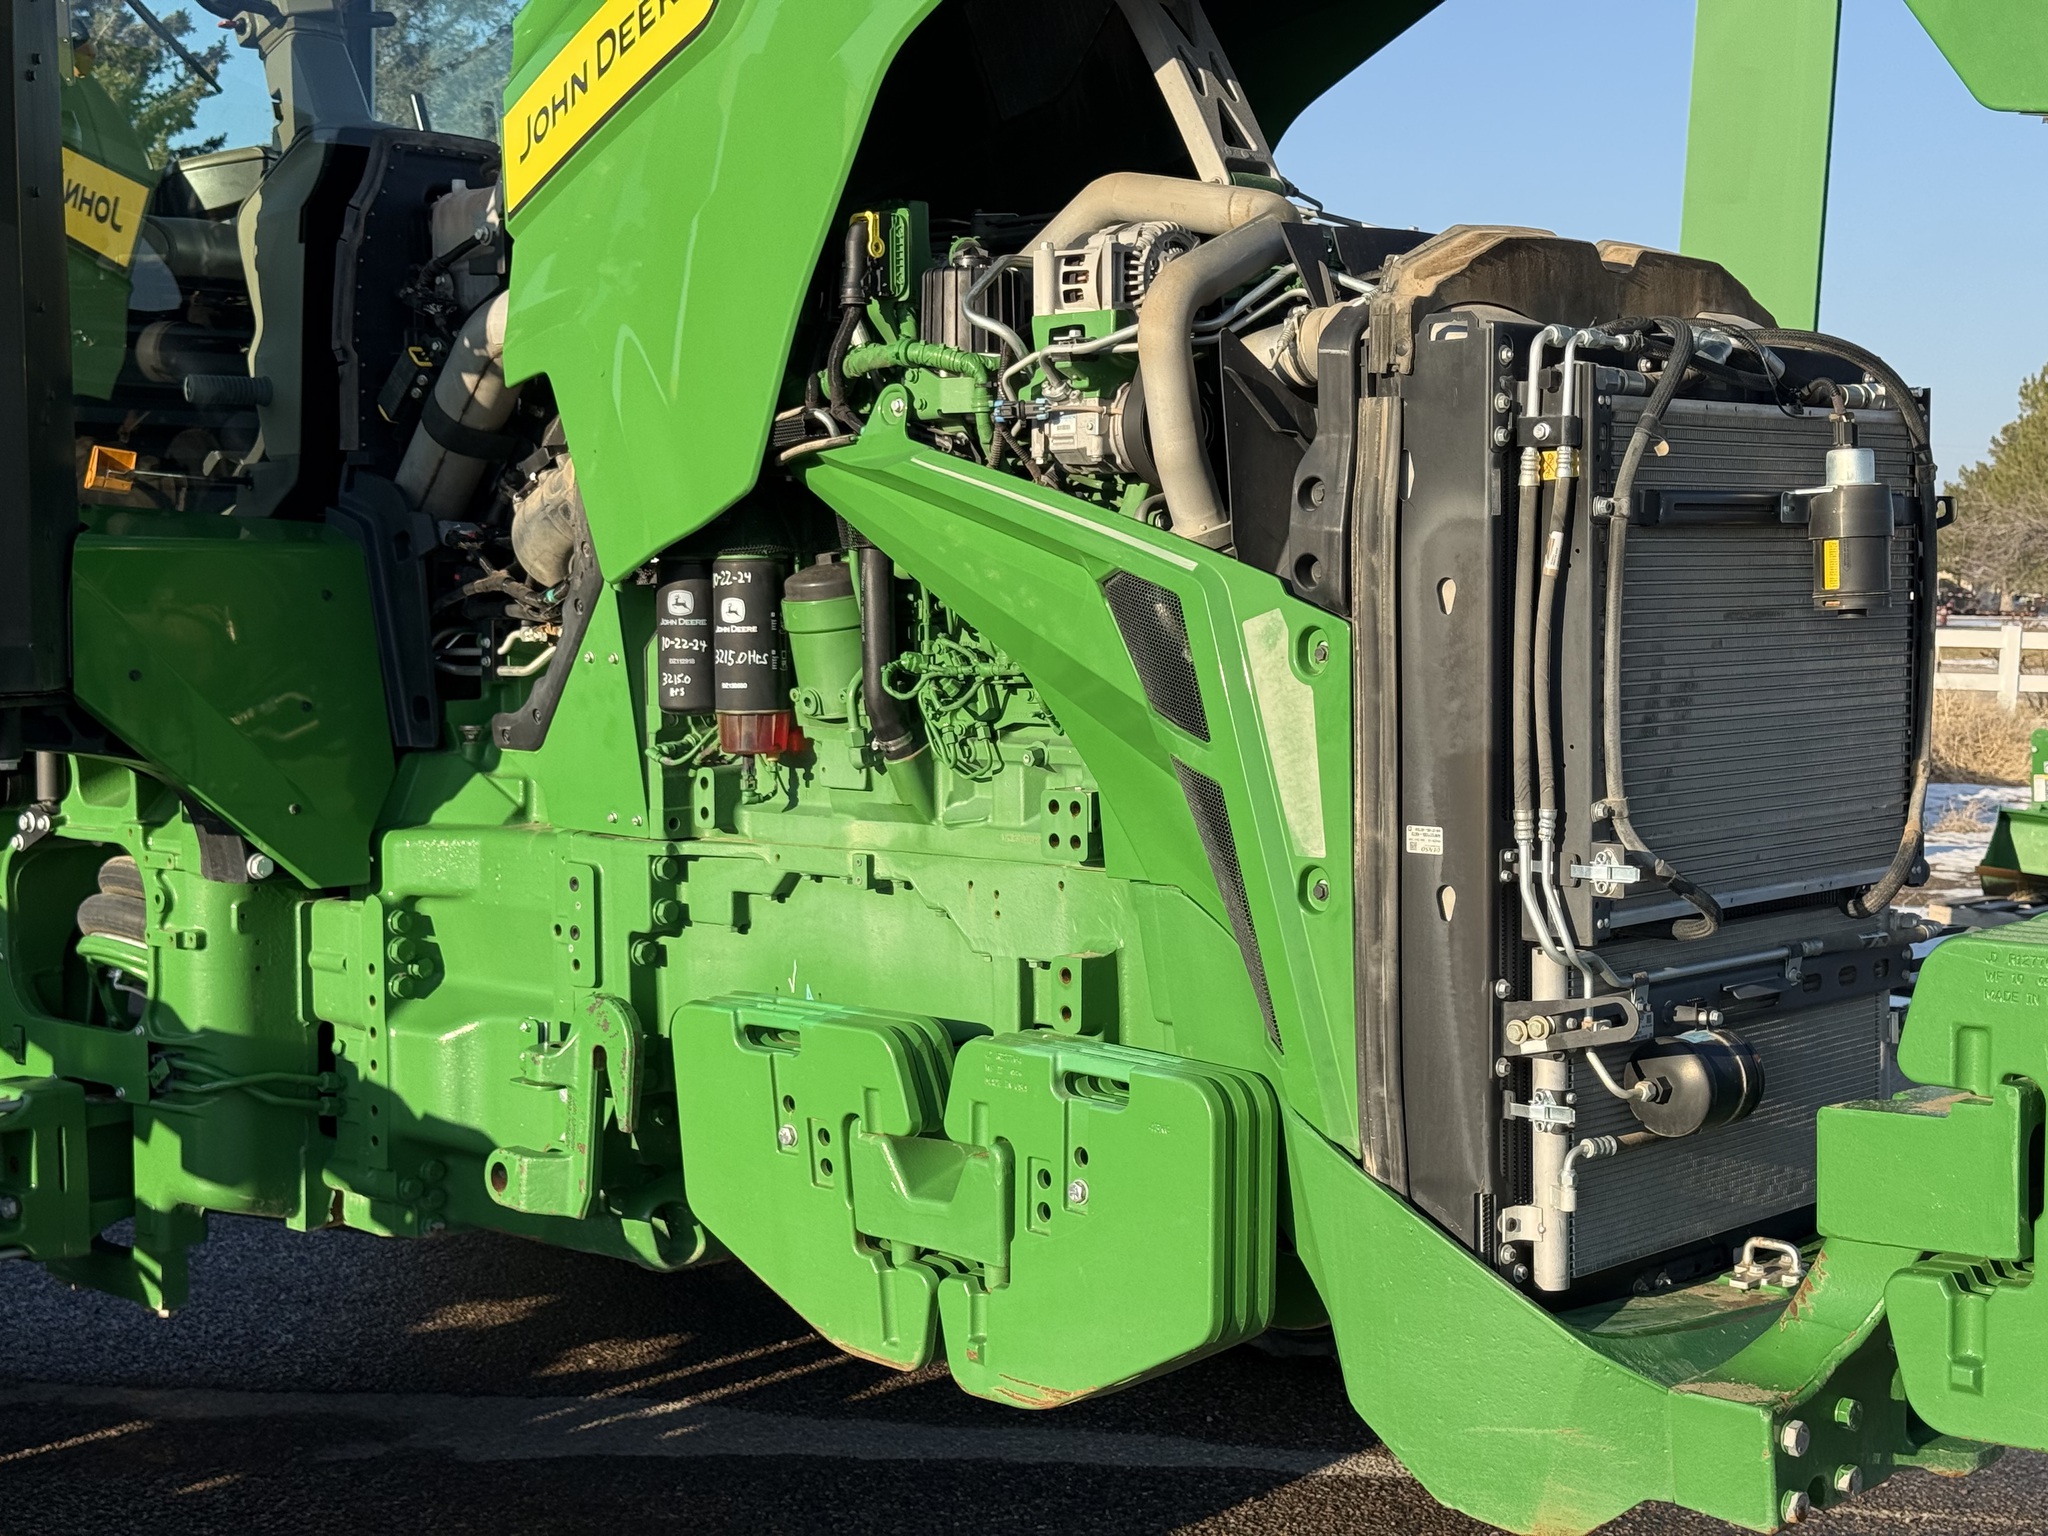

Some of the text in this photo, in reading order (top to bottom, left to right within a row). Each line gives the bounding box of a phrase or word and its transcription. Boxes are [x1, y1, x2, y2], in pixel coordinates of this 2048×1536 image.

[519, 0, 679, 165] JOHN DEE
[660, 618, 707, 626] JOHN DEERE
[730, 625, 758, 633] DEERE
[661, 636, 708, 653] 10-22-24
[1984, 988, 2040, 1006] MADE IN
